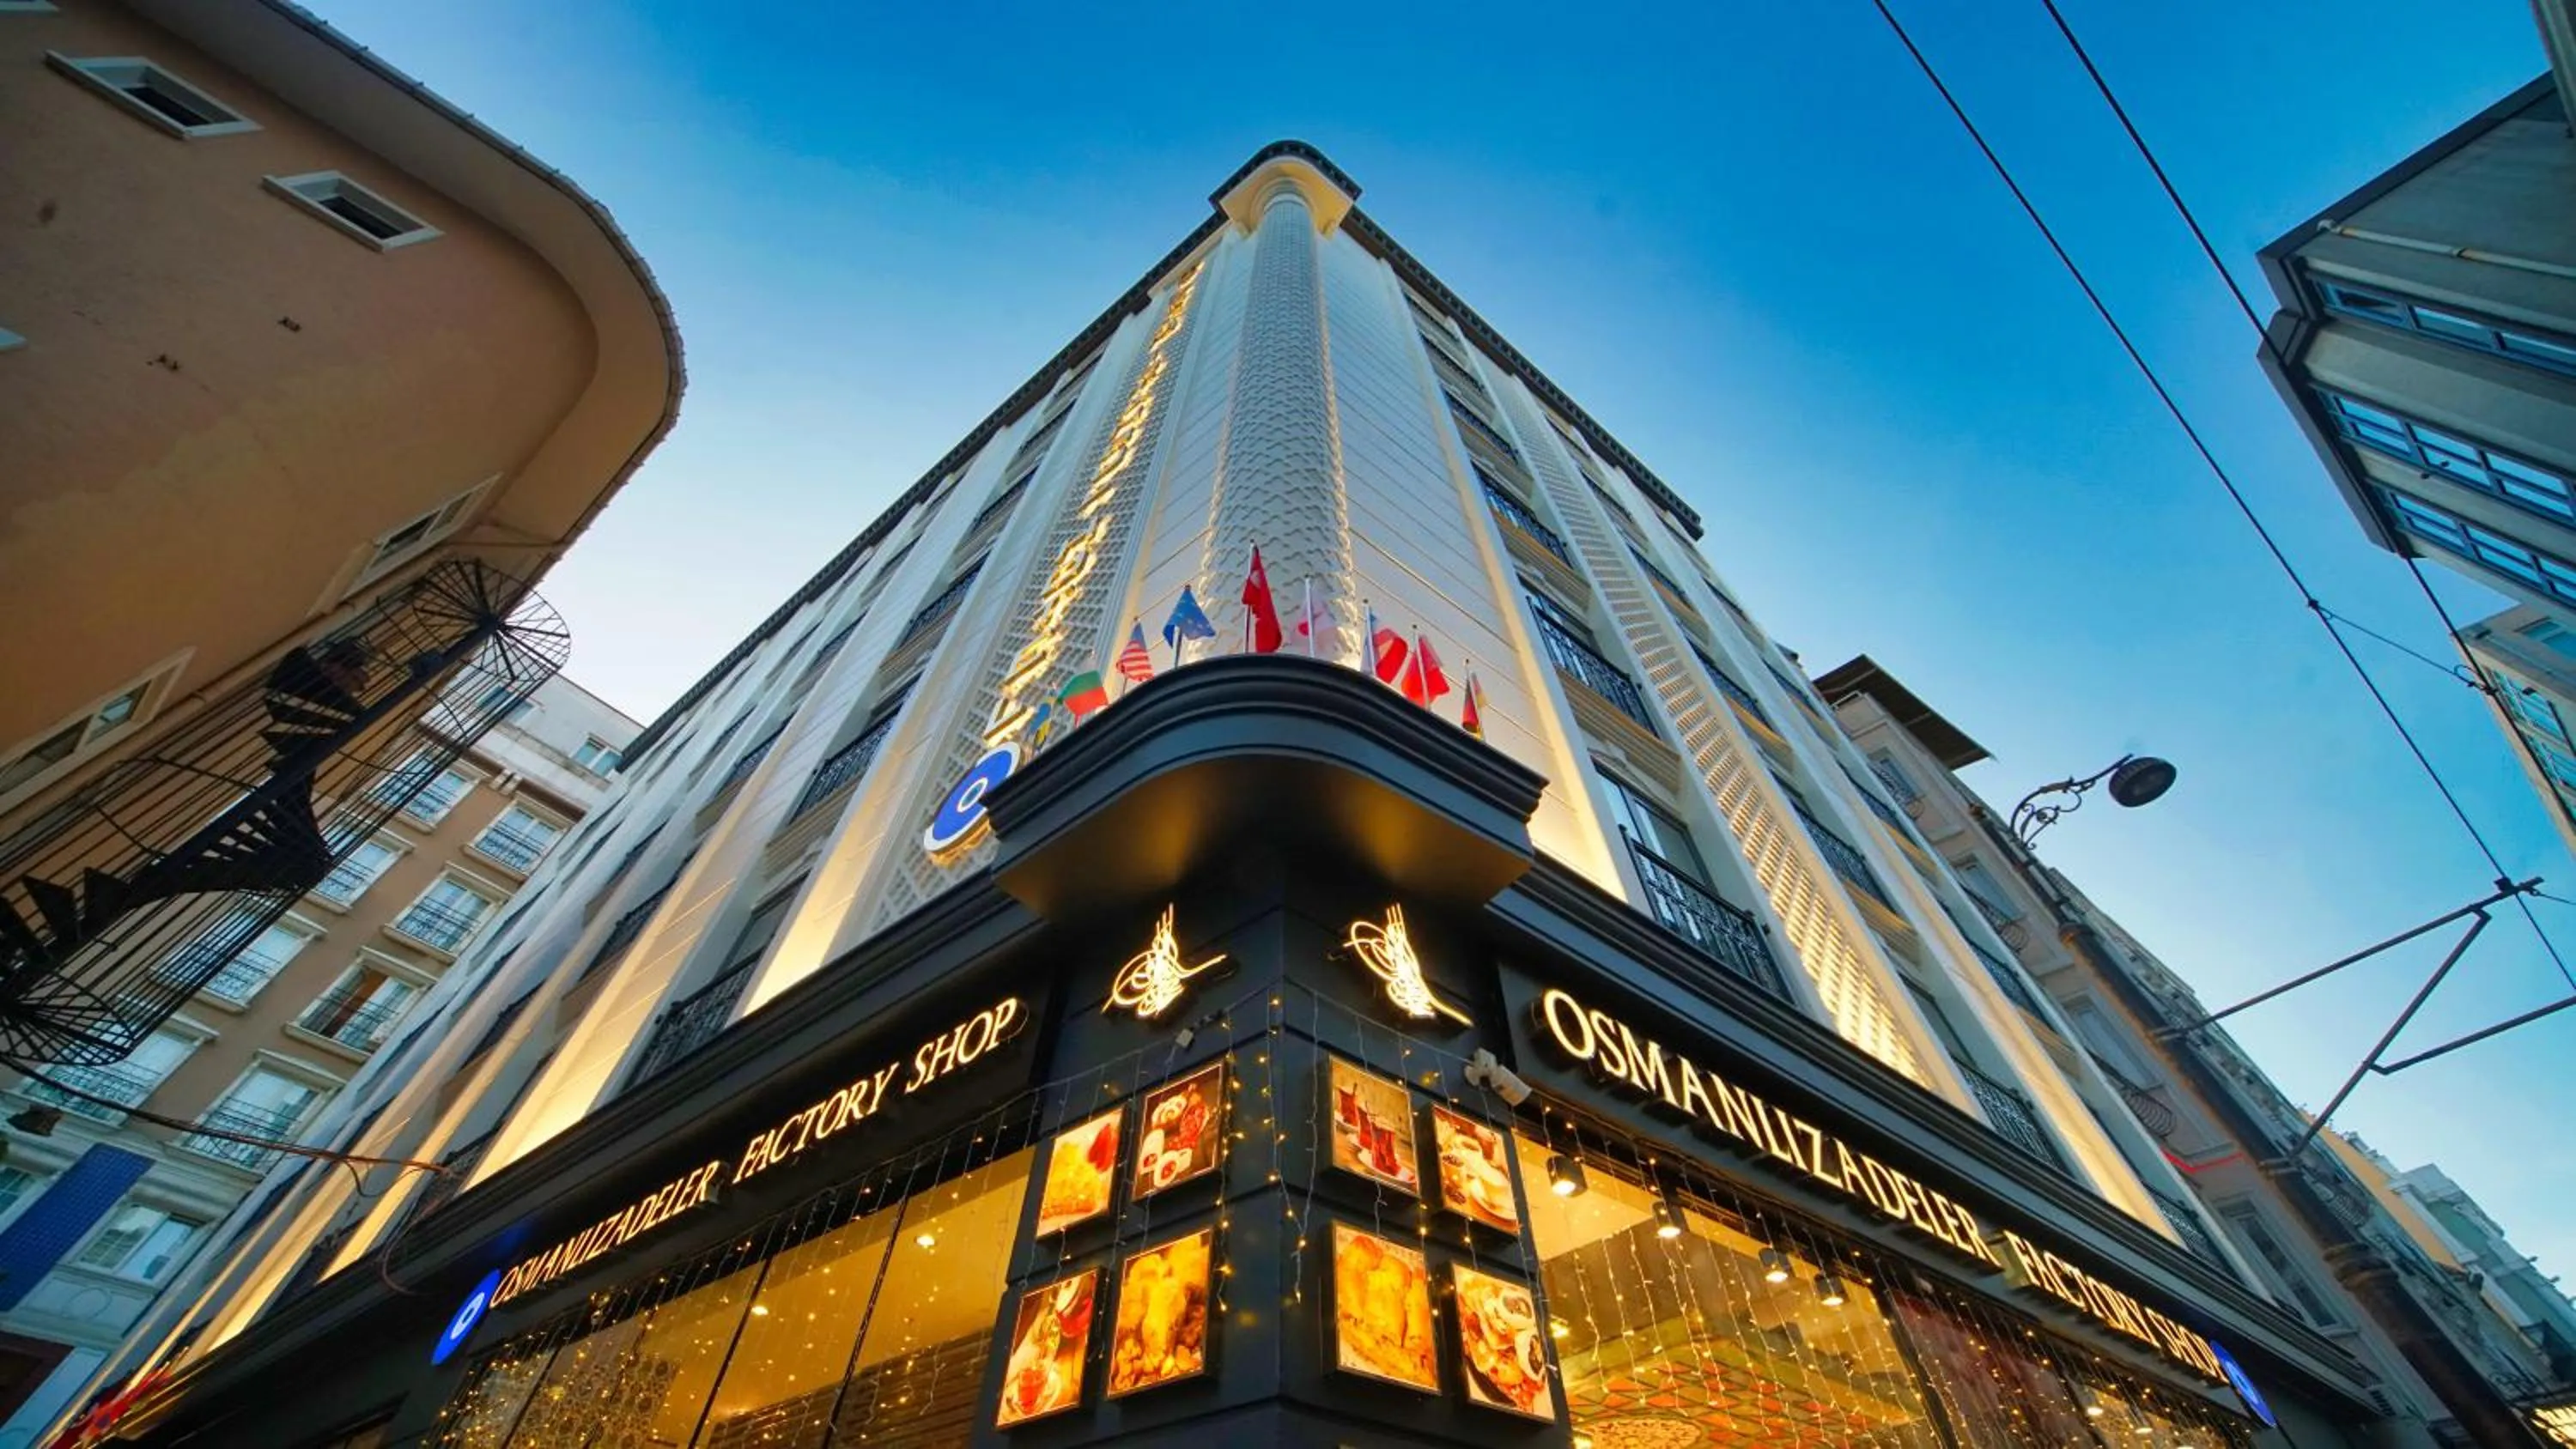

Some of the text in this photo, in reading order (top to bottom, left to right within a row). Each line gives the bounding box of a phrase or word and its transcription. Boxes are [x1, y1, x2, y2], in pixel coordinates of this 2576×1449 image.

[489, 997, 1018, 1309] OSMANLIZADELER FACTORY SHOP
[1544, 989, 2230, 1385] OSMANLIZADELER FACTORY SHOP
